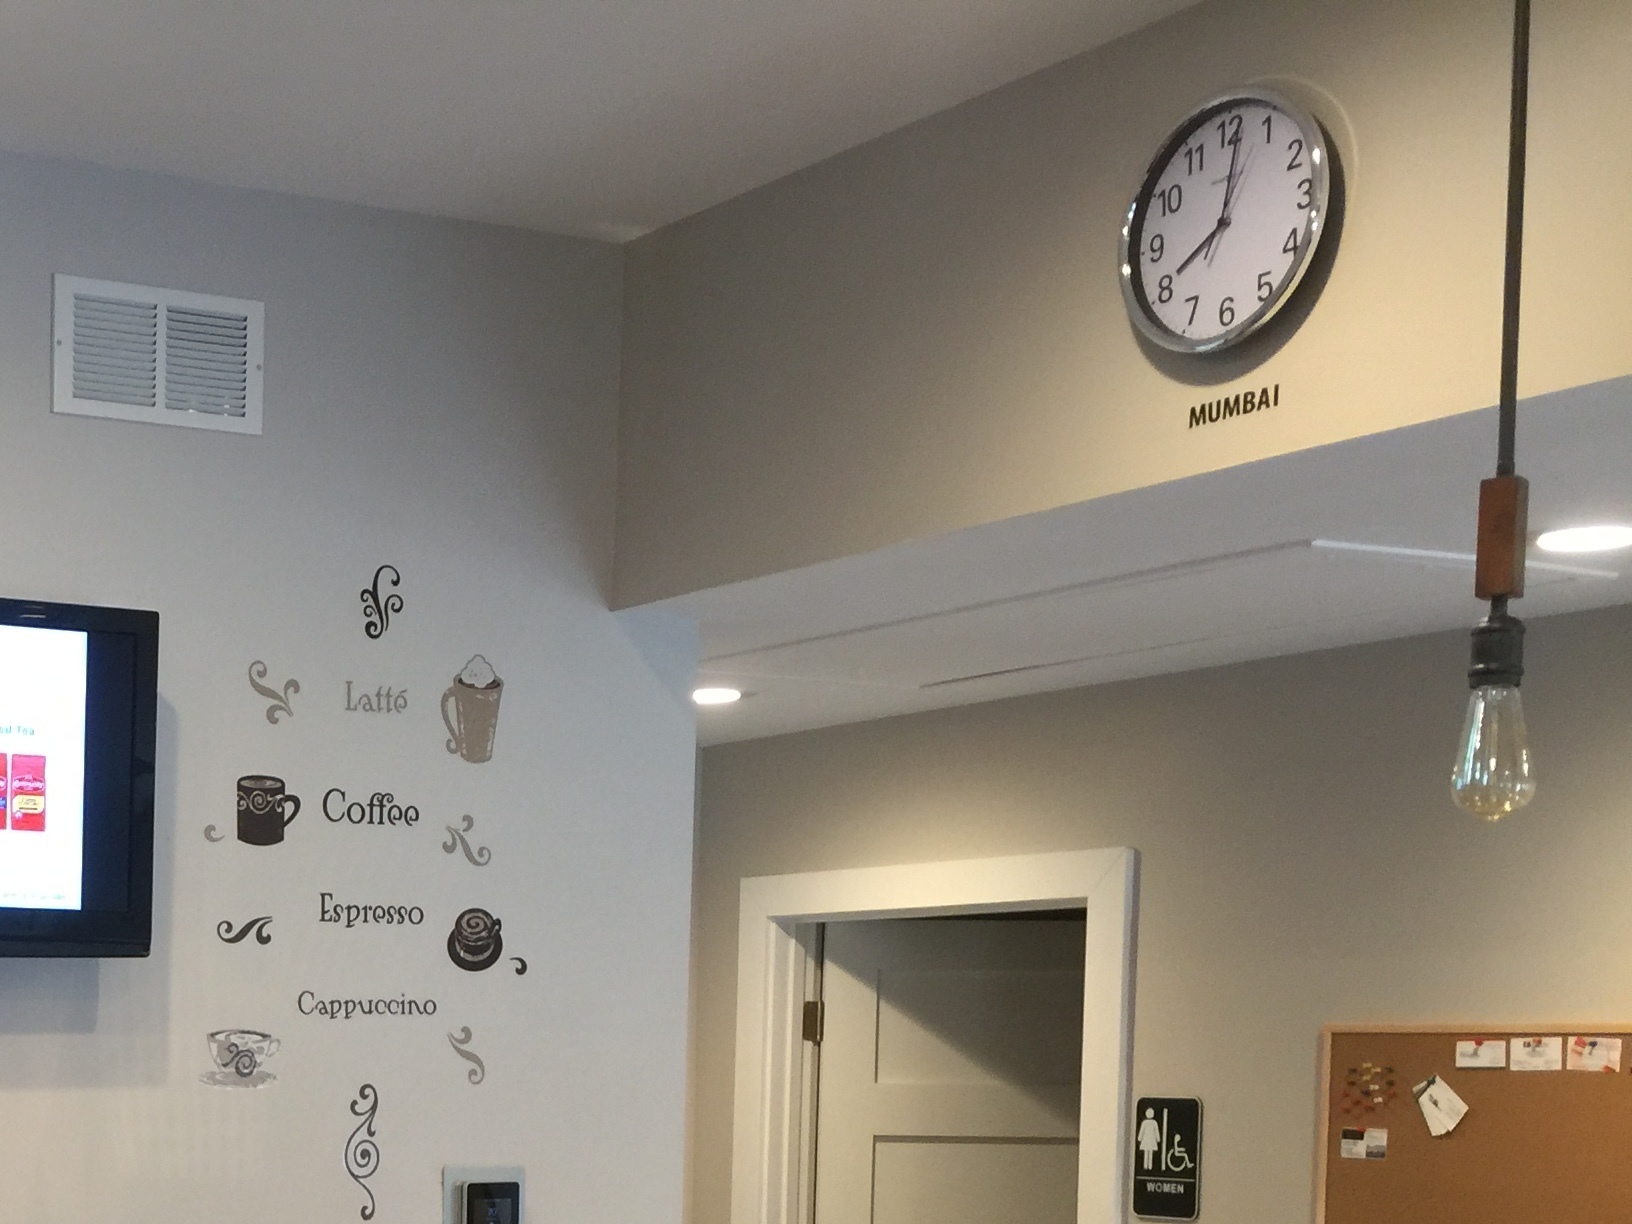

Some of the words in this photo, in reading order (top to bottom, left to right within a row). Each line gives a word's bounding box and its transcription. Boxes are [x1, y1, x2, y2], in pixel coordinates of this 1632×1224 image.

[1217, 114, 1243, 149] 12
[1261, 115, 1273, 144] 1
[1184, 143, 1205, 176] 11
[1286, 138, 1303, 172] 2
[1157, 184, 1183, 217] 10
[1296, 178, 1313, 210] 3
[1149, 233, 1165, 263] 9
[1282, 227, 1300, 261] 4
[1157, 274, 1174, 304] 8
[1256, 270, 1274, 302] 5
[1184, 295, 1200, 326] 7
[1218, 296, 1236, 327] 6
[1188, 383, 1280, 429] MUMBAI
[322, 787, 420, 827] Coffee
[318, 892, 424, 928] Espresso
[297, 990, 438, 1020] Cappuccino
[1146, 1181, 1185, 1195] WOMEN
